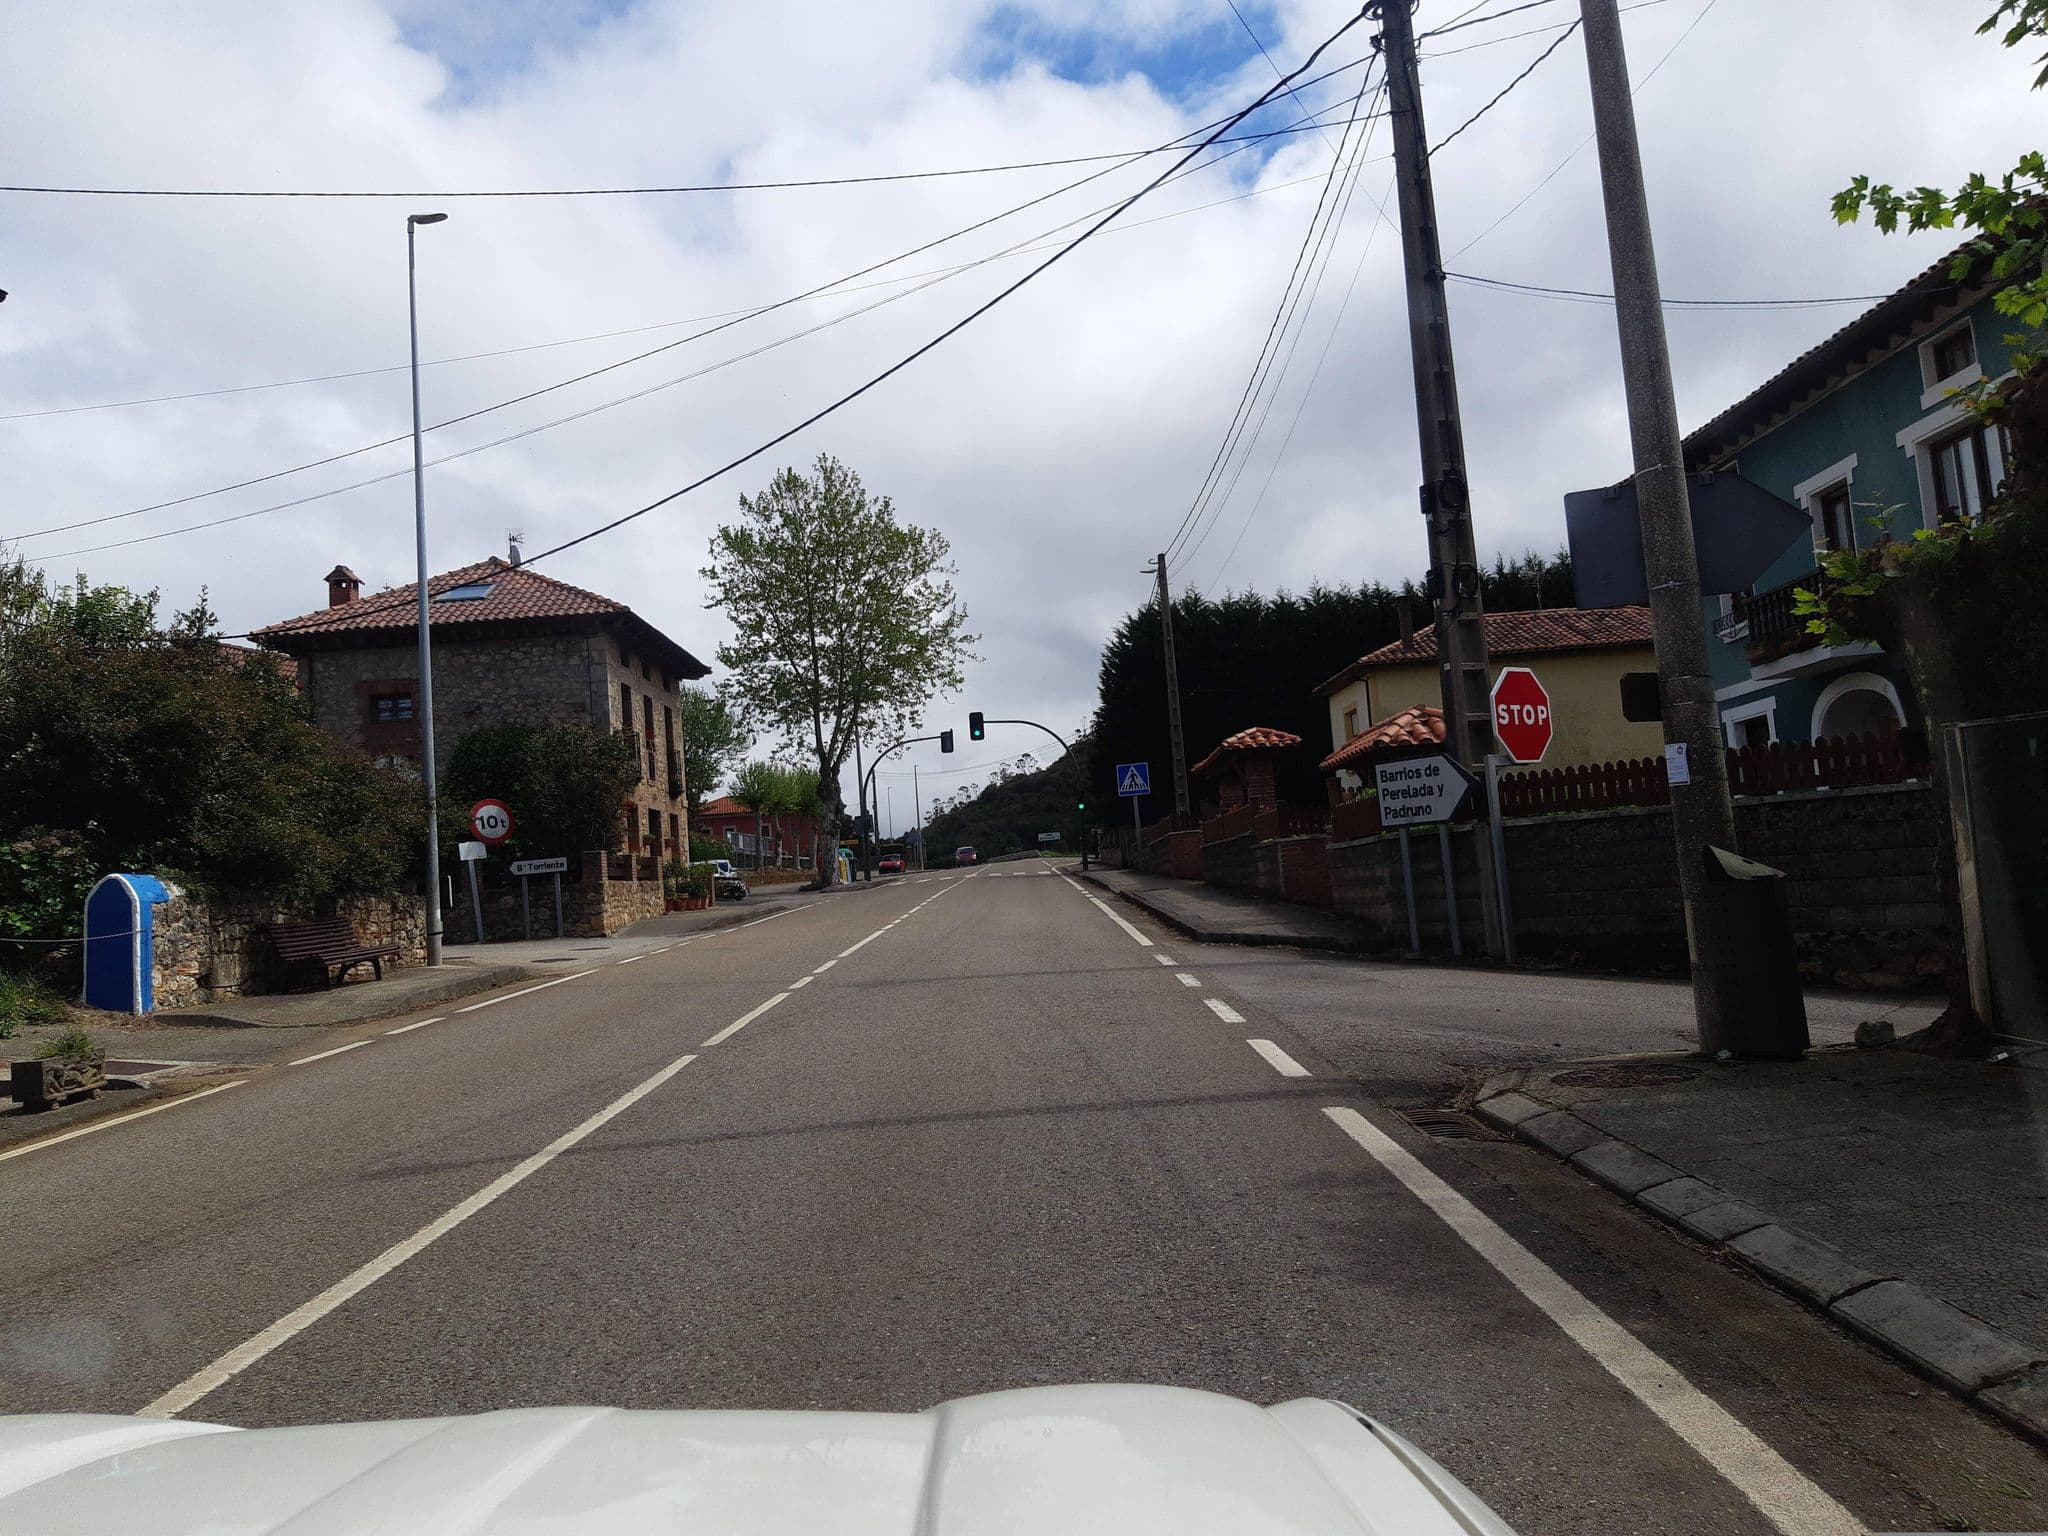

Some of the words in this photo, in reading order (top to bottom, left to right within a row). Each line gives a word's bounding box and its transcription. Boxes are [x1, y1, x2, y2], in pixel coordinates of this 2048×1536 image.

[1497, 703, 1548, 726] STOP
[1380, 766, 1422, 783] Barrios
[1424, 763, 1441, 777] de
[1382, 783, 1434, 801] Perelada
[1437, 783, 1445, 798] y
[1384, 804, 1432, 819] Padruno
[528, 861, 565, 871] Torriente
